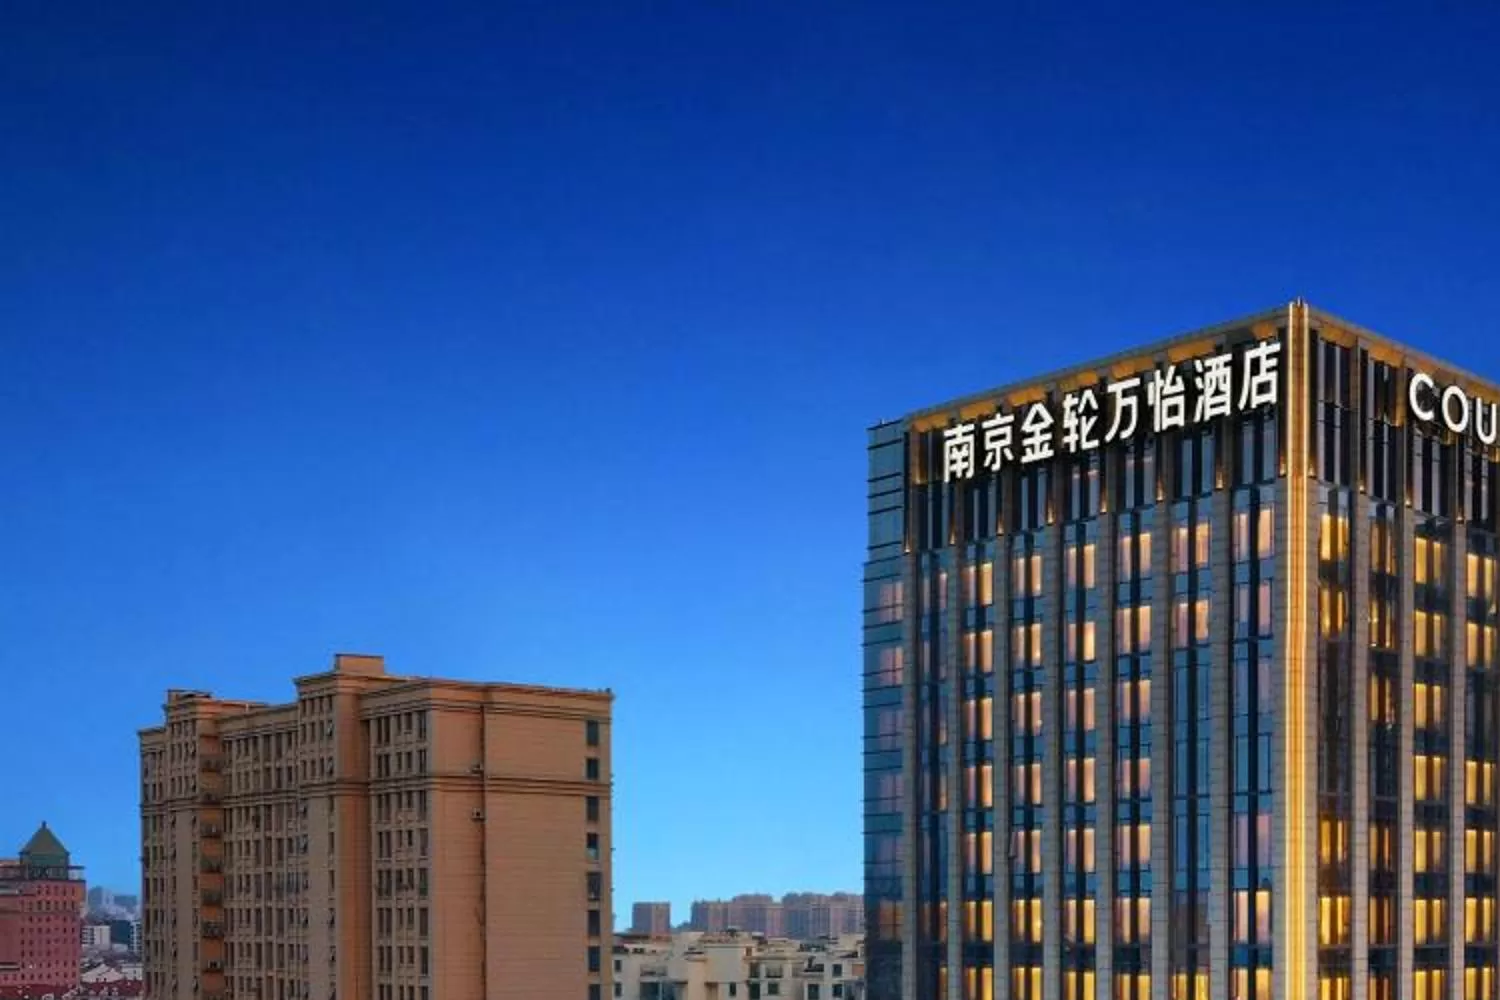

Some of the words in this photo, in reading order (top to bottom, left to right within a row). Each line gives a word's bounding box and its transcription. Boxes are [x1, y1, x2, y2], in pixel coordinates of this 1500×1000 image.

[943, 340, 1282, 483] 南京金轮万怡酒店
